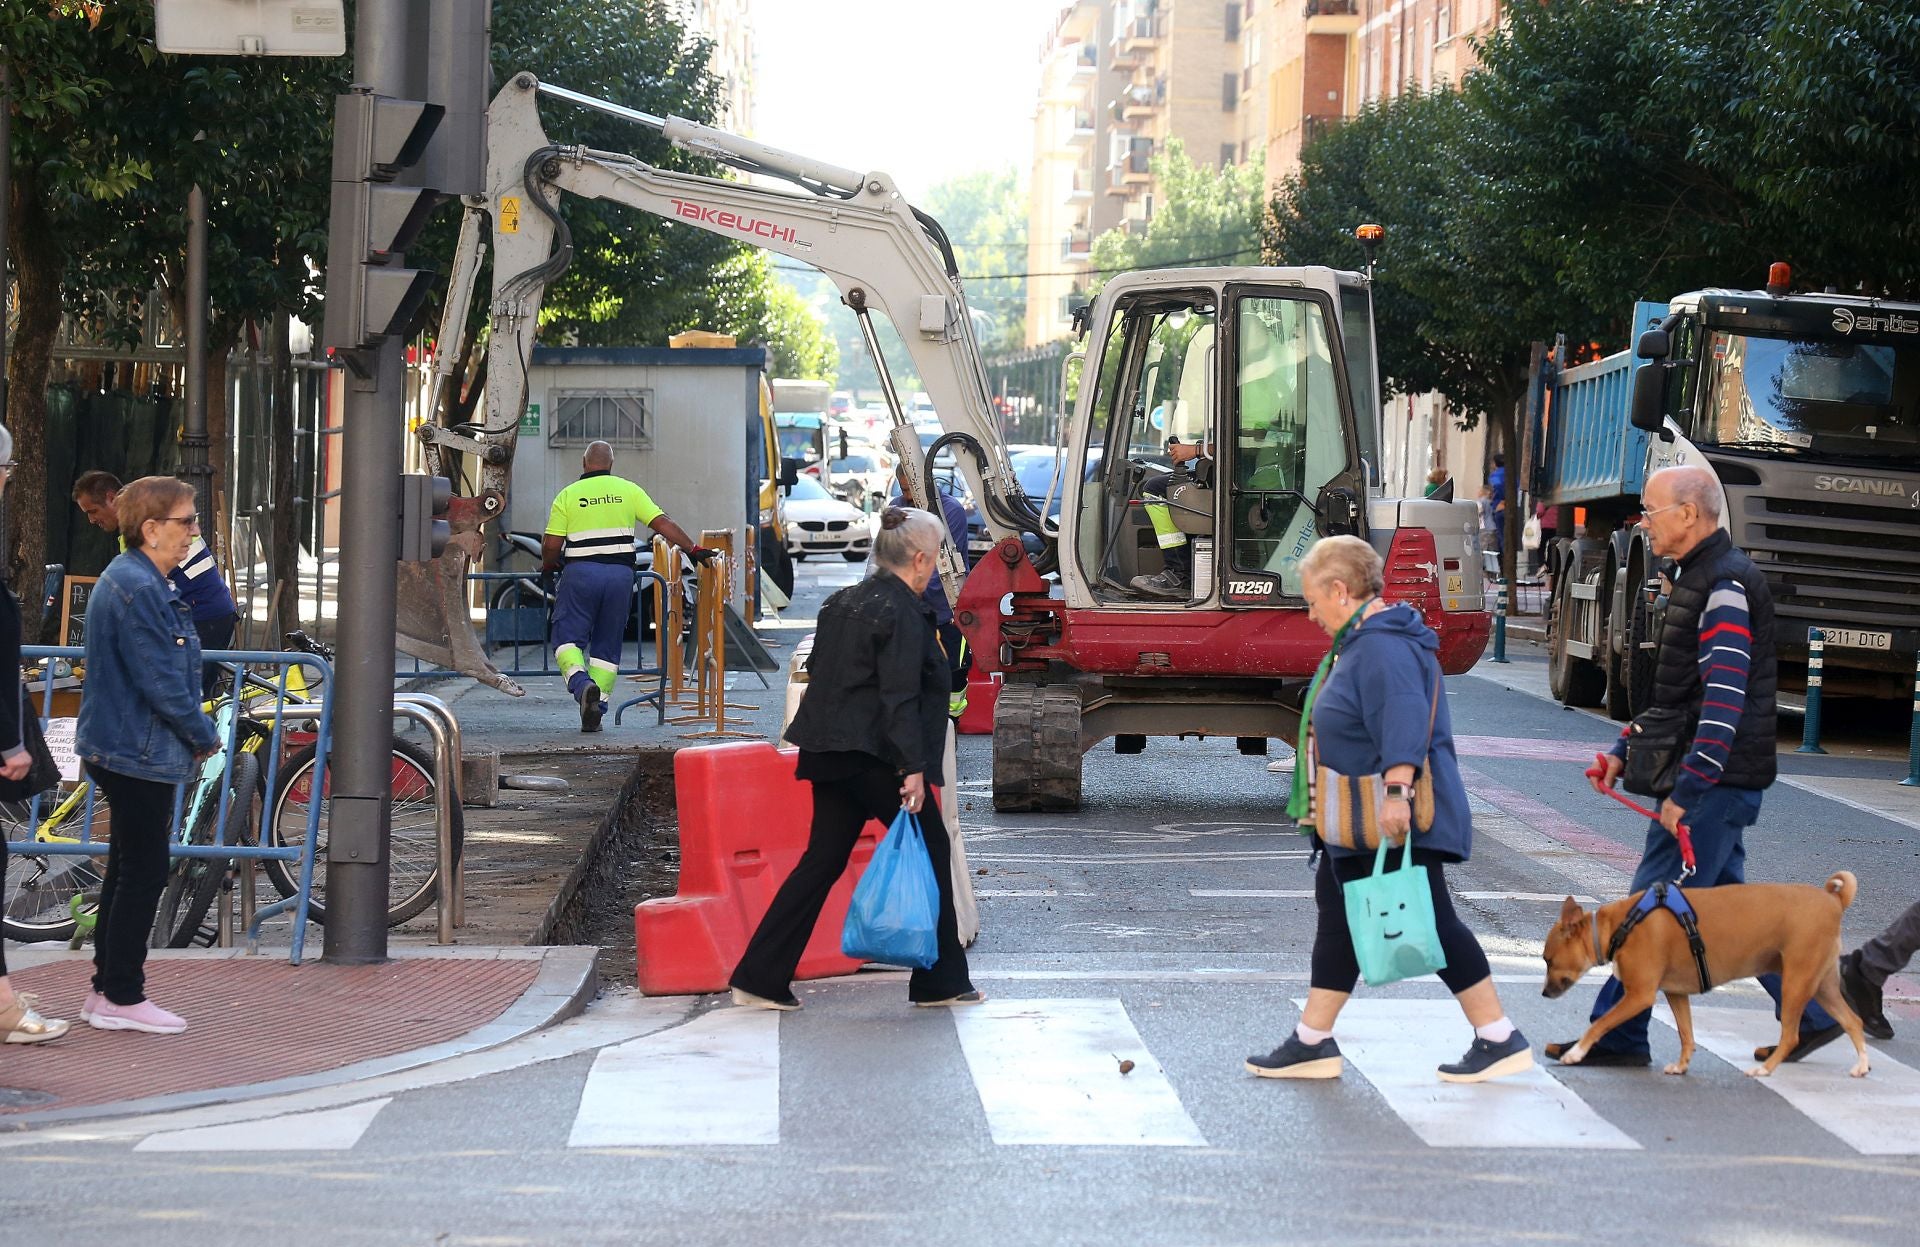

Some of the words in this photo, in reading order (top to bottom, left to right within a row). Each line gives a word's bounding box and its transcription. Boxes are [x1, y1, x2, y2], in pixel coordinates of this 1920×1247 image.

[671, 199, 796, 243] TAKEUCHI
[1855, 314, 1919, 334] antis
[1814, 475, 1905, 497] SCANIA
[589, 494, 623, 505] antis
[1291, 518, 1316, 558] antis
[1228, 581, 1274, 595] TB250
[1859, 632, 1886, 647] DTC
